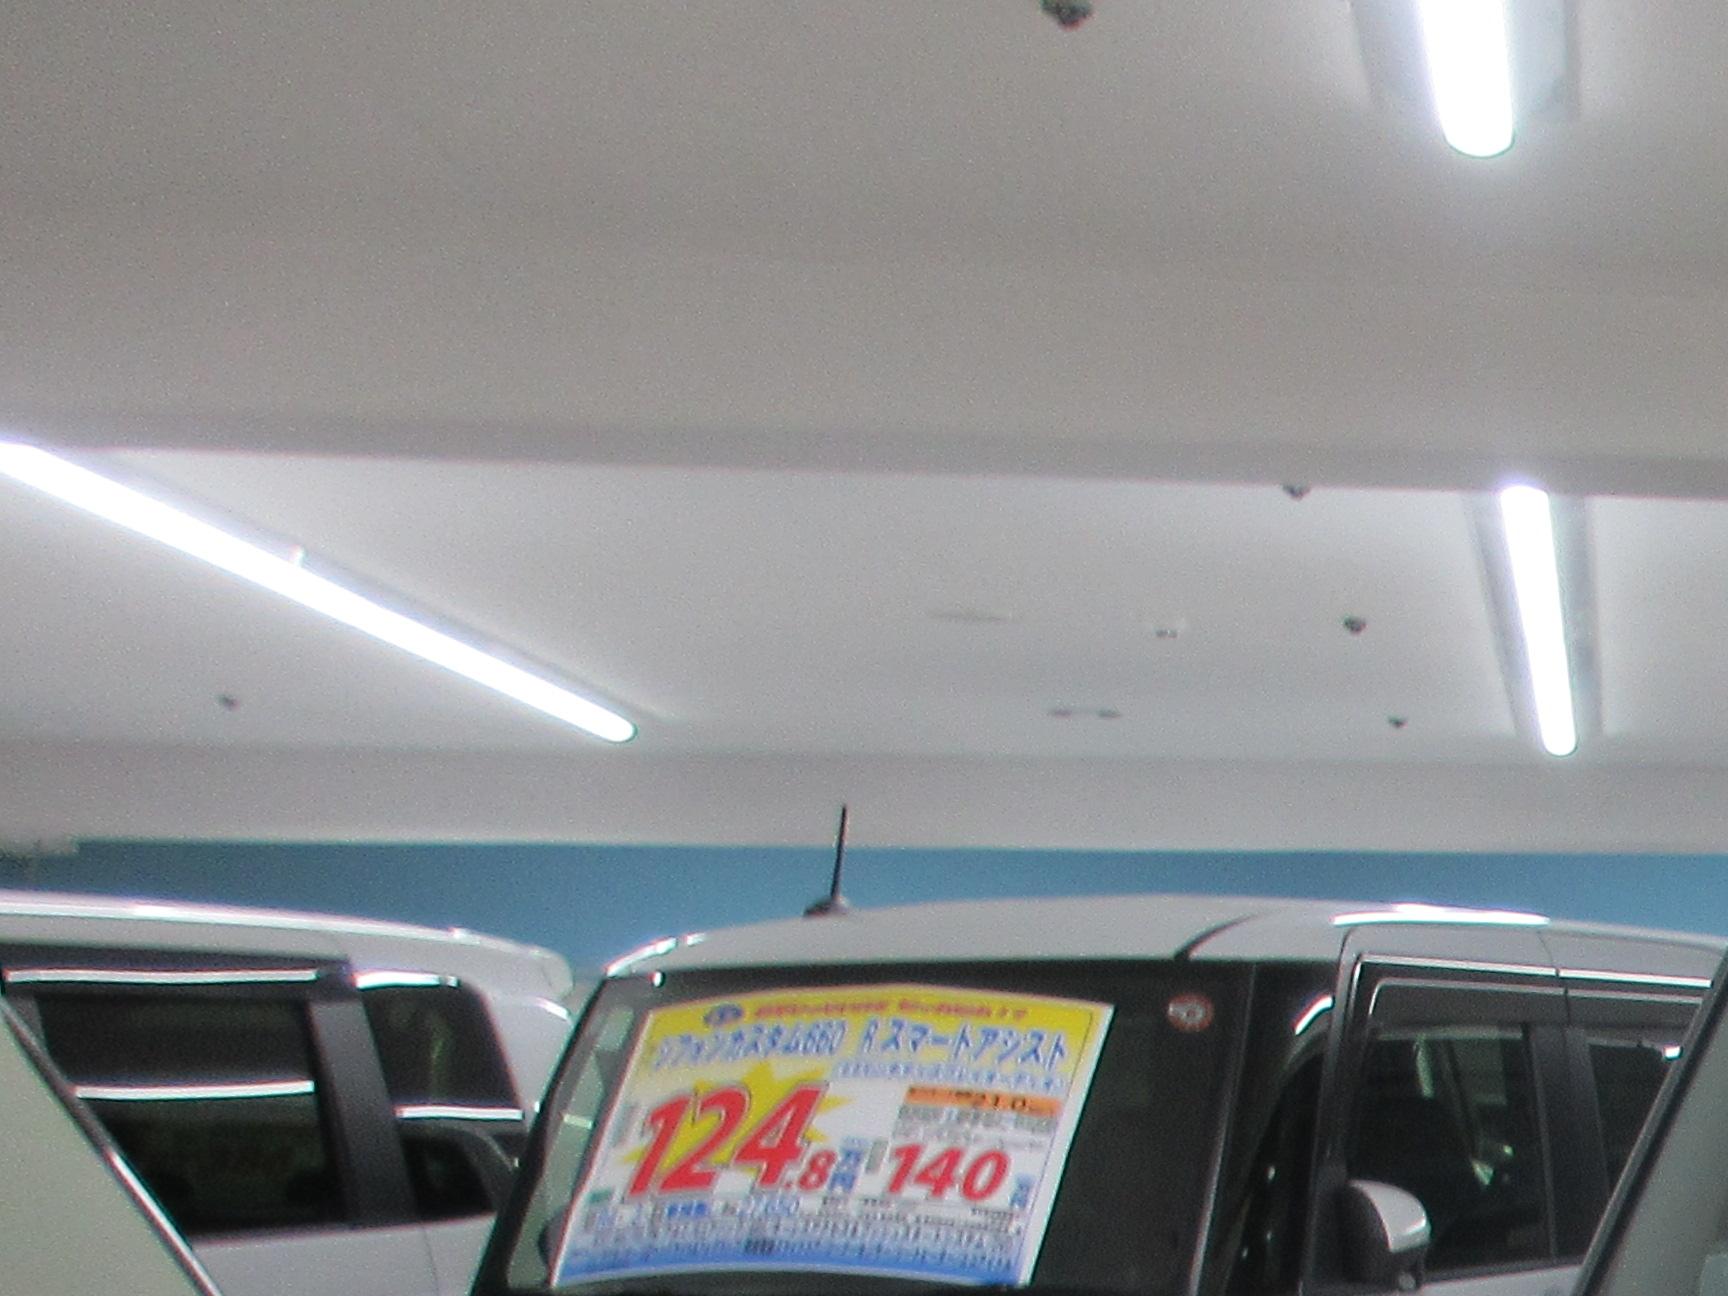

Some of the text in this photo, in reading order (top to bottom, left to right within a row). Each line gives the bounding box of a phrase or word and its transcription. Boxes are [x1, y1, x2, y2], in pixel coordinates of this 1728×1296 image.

[881, 1017, 1065, 1070] スマートアシスト
[628, 1081, 837, 1198] 124.8
[889, 1144, 1011, 1200] 140
